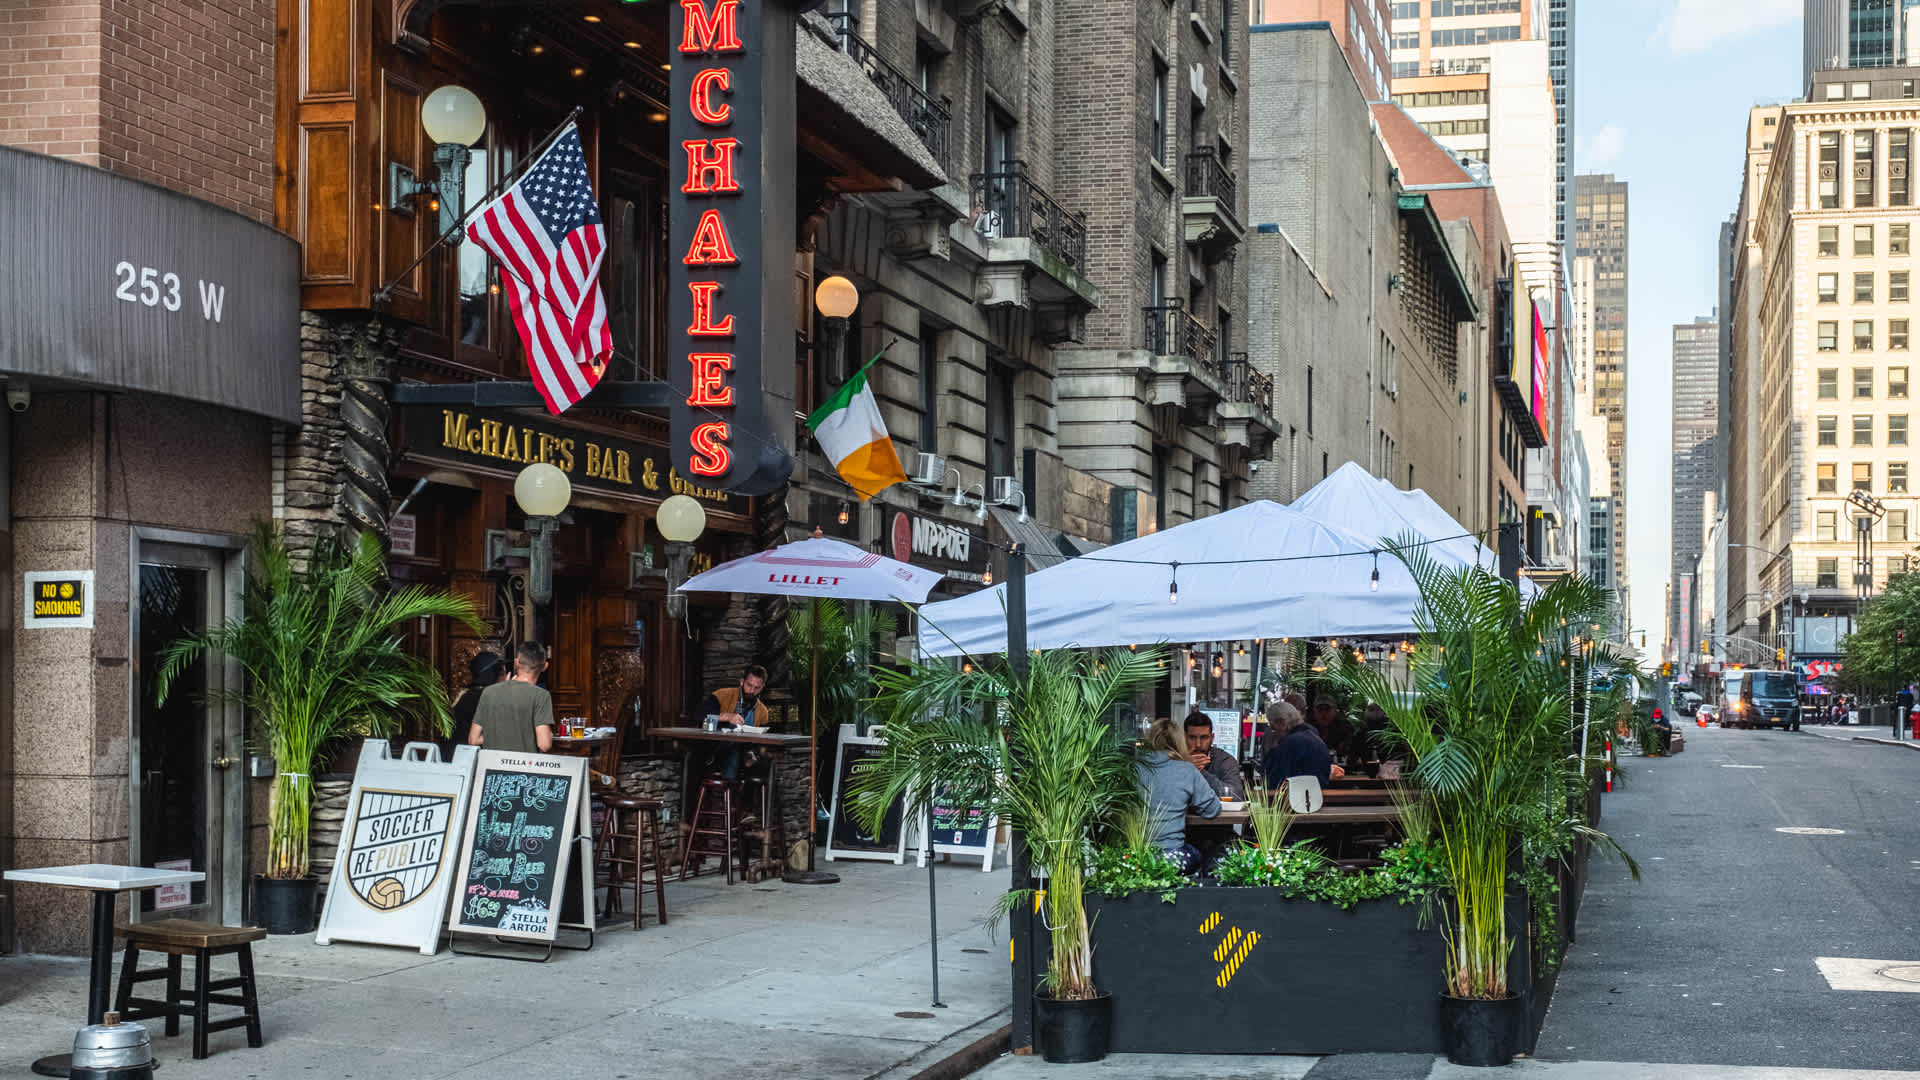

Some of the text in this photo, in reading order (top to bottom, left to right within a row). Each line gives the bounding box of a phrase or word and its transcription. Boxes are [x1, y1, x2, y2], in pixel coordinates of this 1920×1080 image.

[677, 0, 743, 478] MCHALES
[115, 260, 226, 323] 253 W
[442, 409, 576, 473] McHALE'S
[586, 442, 633, 485] BAR
[642, 458, 660, 491] &
[911, 516, 971, 563] NIPPORI
[42, 583, 57, 598] NO
[768, 573, 846, 586] LILLET
[35, 600, 82, 616] SMOKING
[501, 758, 561, 769] STELLA ARTOIS
[369, 808, 435, 842] SOCCER
[353, 838, 437, 875] REPUBLIC
[509, 923, 548, 933] ARTOIS
[511, 913, 548, 923] STELLA
